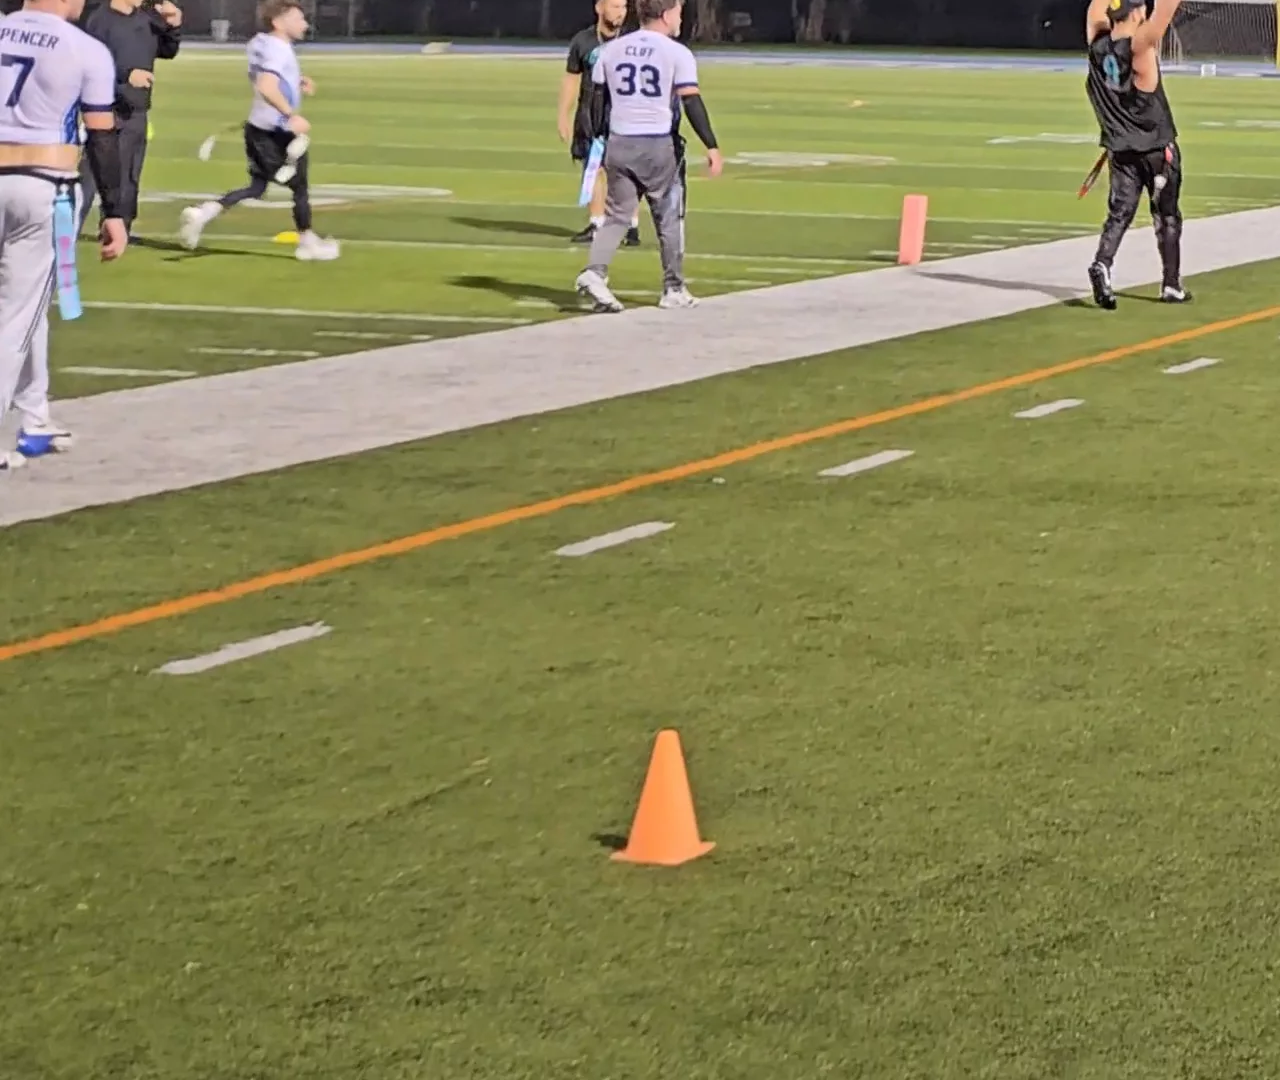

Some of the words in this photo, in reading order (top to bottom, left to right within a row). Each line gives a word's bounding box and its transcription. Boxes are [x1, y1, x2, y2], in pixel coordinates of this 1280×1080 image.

[0, 27, 60, 50] PENCER
[1, 53, 35, 107] 7
[615, 63, 662, 97] 33
